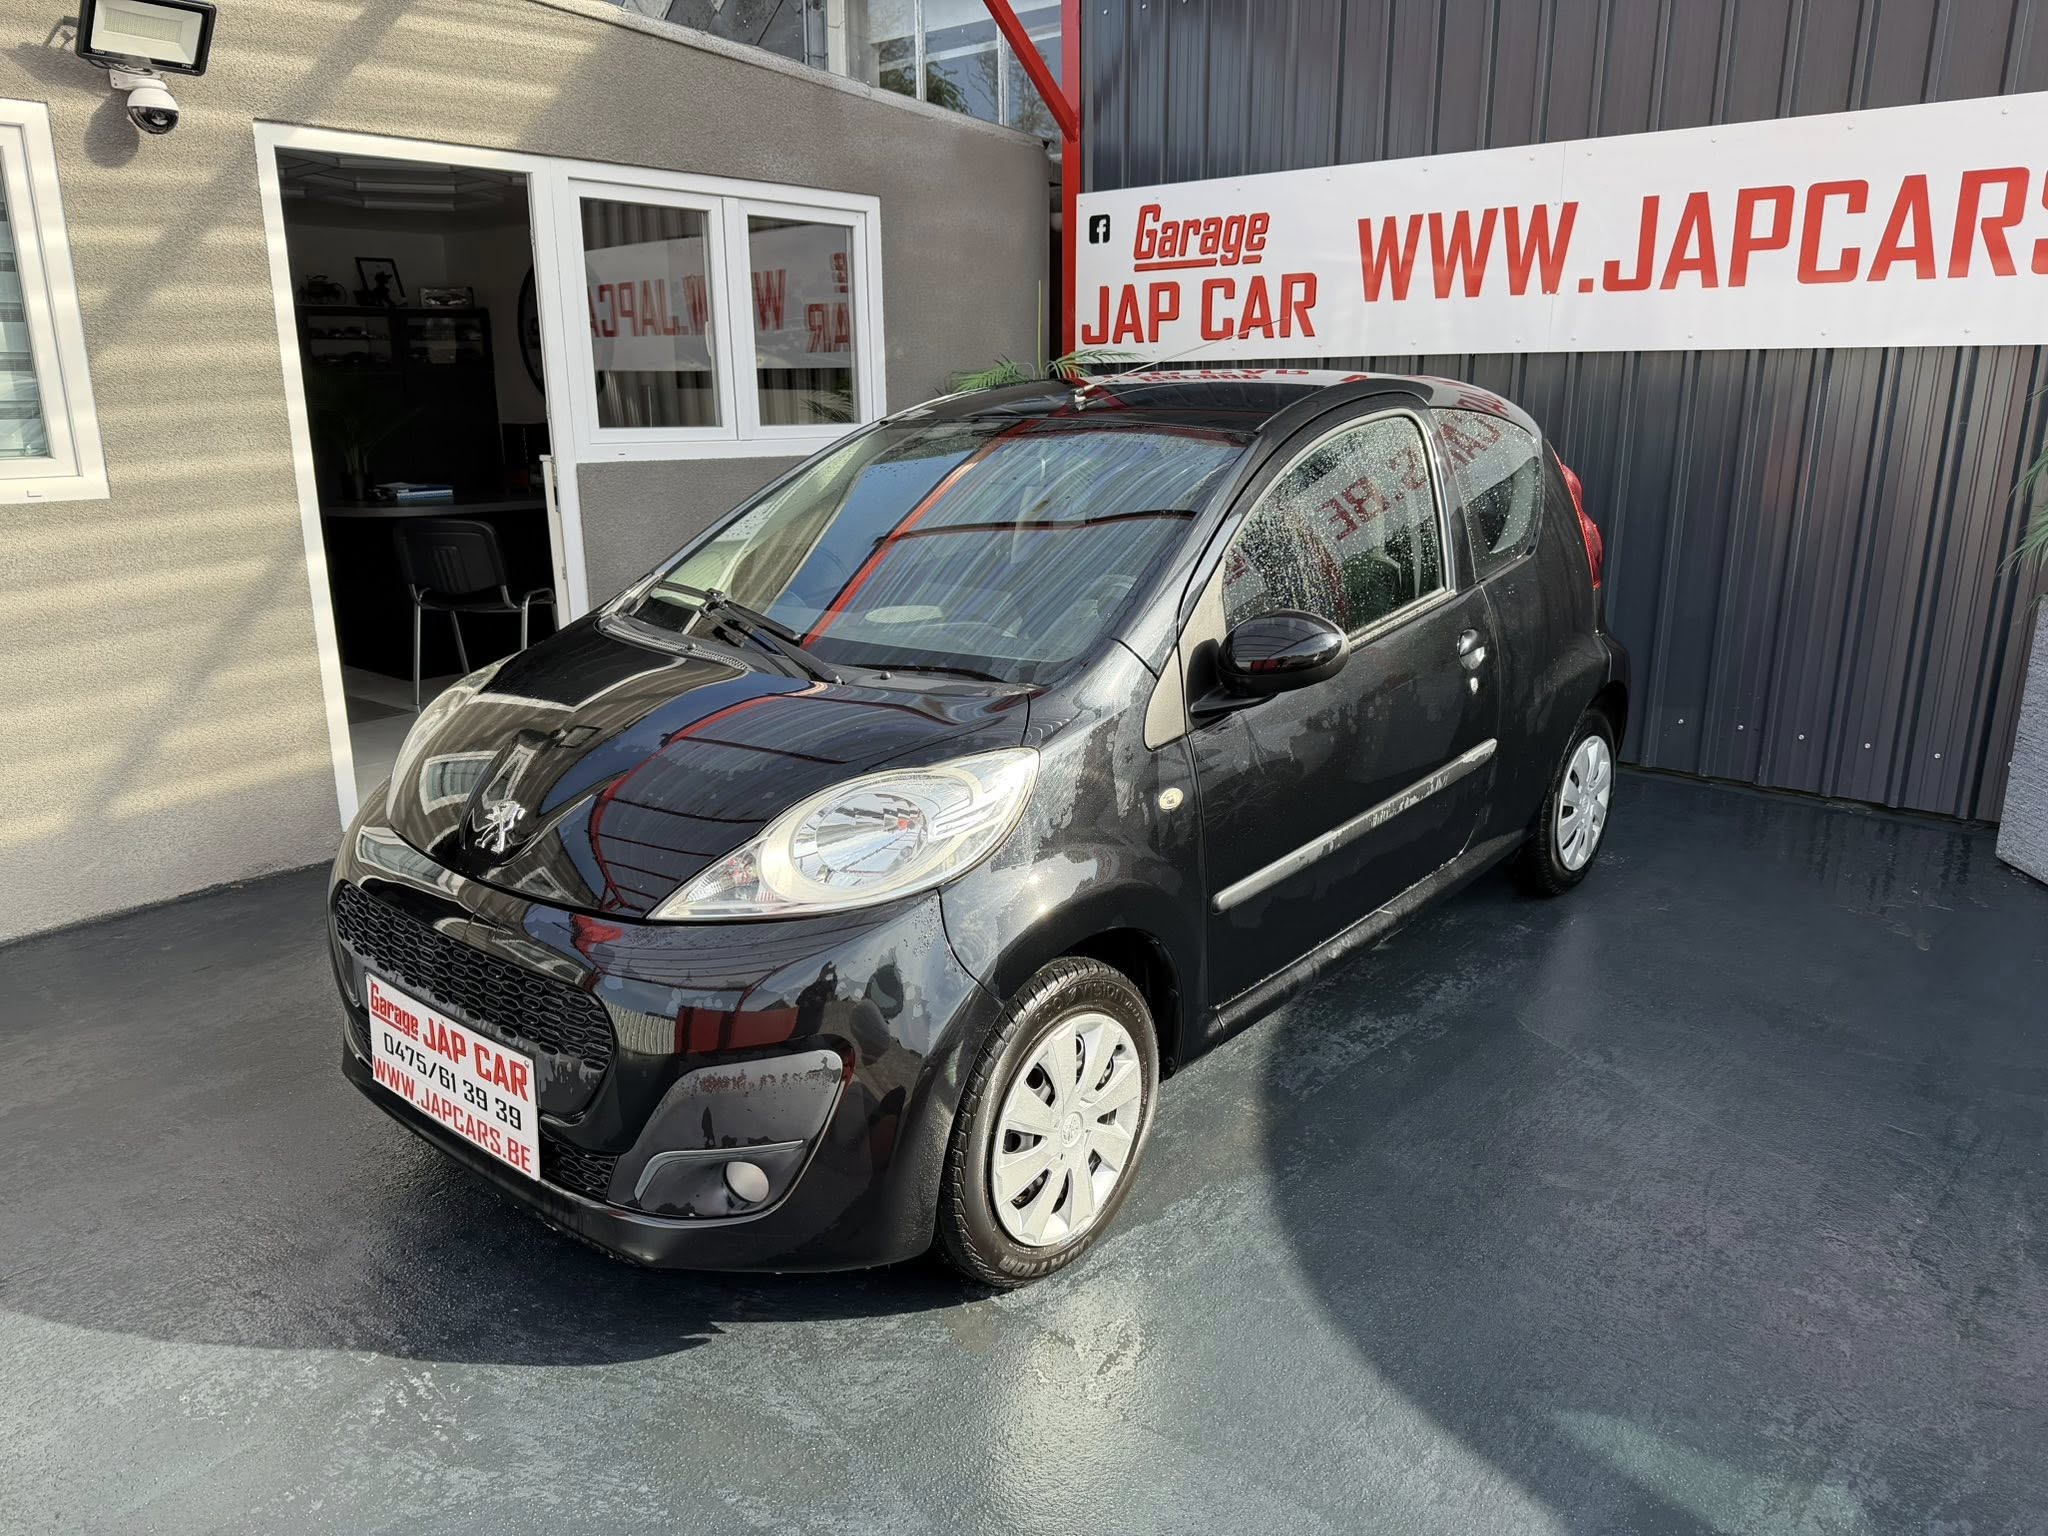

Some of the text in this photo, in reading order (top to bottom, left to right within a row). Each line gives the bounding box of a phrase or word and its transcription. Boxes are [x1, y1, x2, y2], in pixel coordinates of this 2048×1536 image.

[1133, 204, 1270, 267] Garage
[1357, 166, 2048, 302] WWW.JAPCAR
[1081, 272, 1317, 344] JAP CAR
[370, 982, 529, 1101] Garage JAP CAR
[383, 1032, 522, 1131] 0475/61 39 39
[373, 1055, 532, 1173] WWW.JAPCARS.BE
